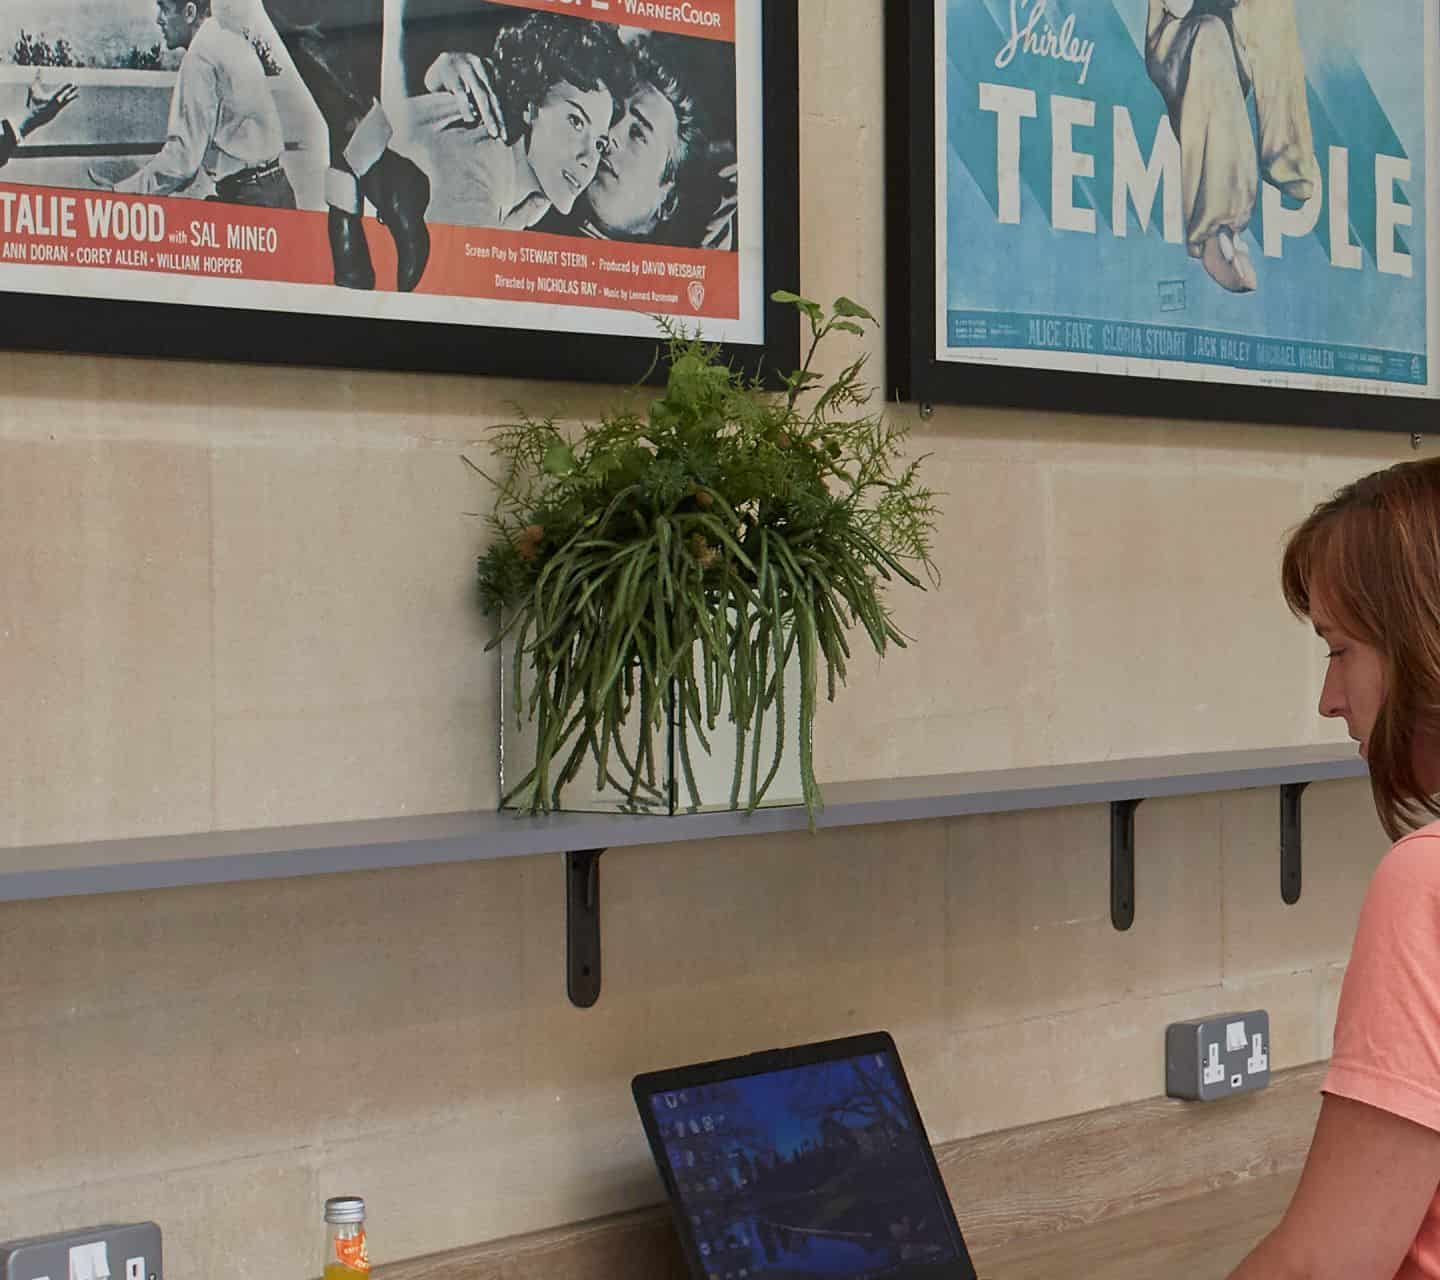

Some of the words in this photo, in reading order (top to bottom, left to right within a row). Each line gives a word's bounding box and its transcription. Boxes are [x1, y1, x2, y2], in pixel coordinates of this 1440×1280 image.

[977, 81, 1414, 278] TEMPLE
[84, 198, 165, 242] WOOD
[169, 230, 188, 244] with
[190, 220, 220, 248] SAL
[227, 223, 278, 253] MINEO
[2, 241, 26, 259] ANN
[31, 244, 68, 262] DORAN
[76, 247, 112, 264] COREY
[115, 249, 148, 267] ALLEN
[156, 252, 200, 272] WILLIAM
[203, 256, 243, 274] HOPPER
[507, 247, 517, 263] by
[519, 247, 560, 265] STEWART
[560, 251, 588, 269] STERN
[599, 258, 631, 273] Produced
[642, 259, 666, 276] DAVID
[494, 273, 525, 289] Directed
[526, 276, 535, 292] by
[536, 276, 579, 295] NICHOLAS
[580, 280, 598, 297] RAY
[1028, 319, 1061, 347] ALICE
[1065, 321, 1095, 351] FAYE
[1102, 324, 1142, 354] GLORIA
[1144, 327, 1187, 356] STUART
[1193, 334, 1217, 358] JACK
[1220, 336, 1250, 361] HALEY
